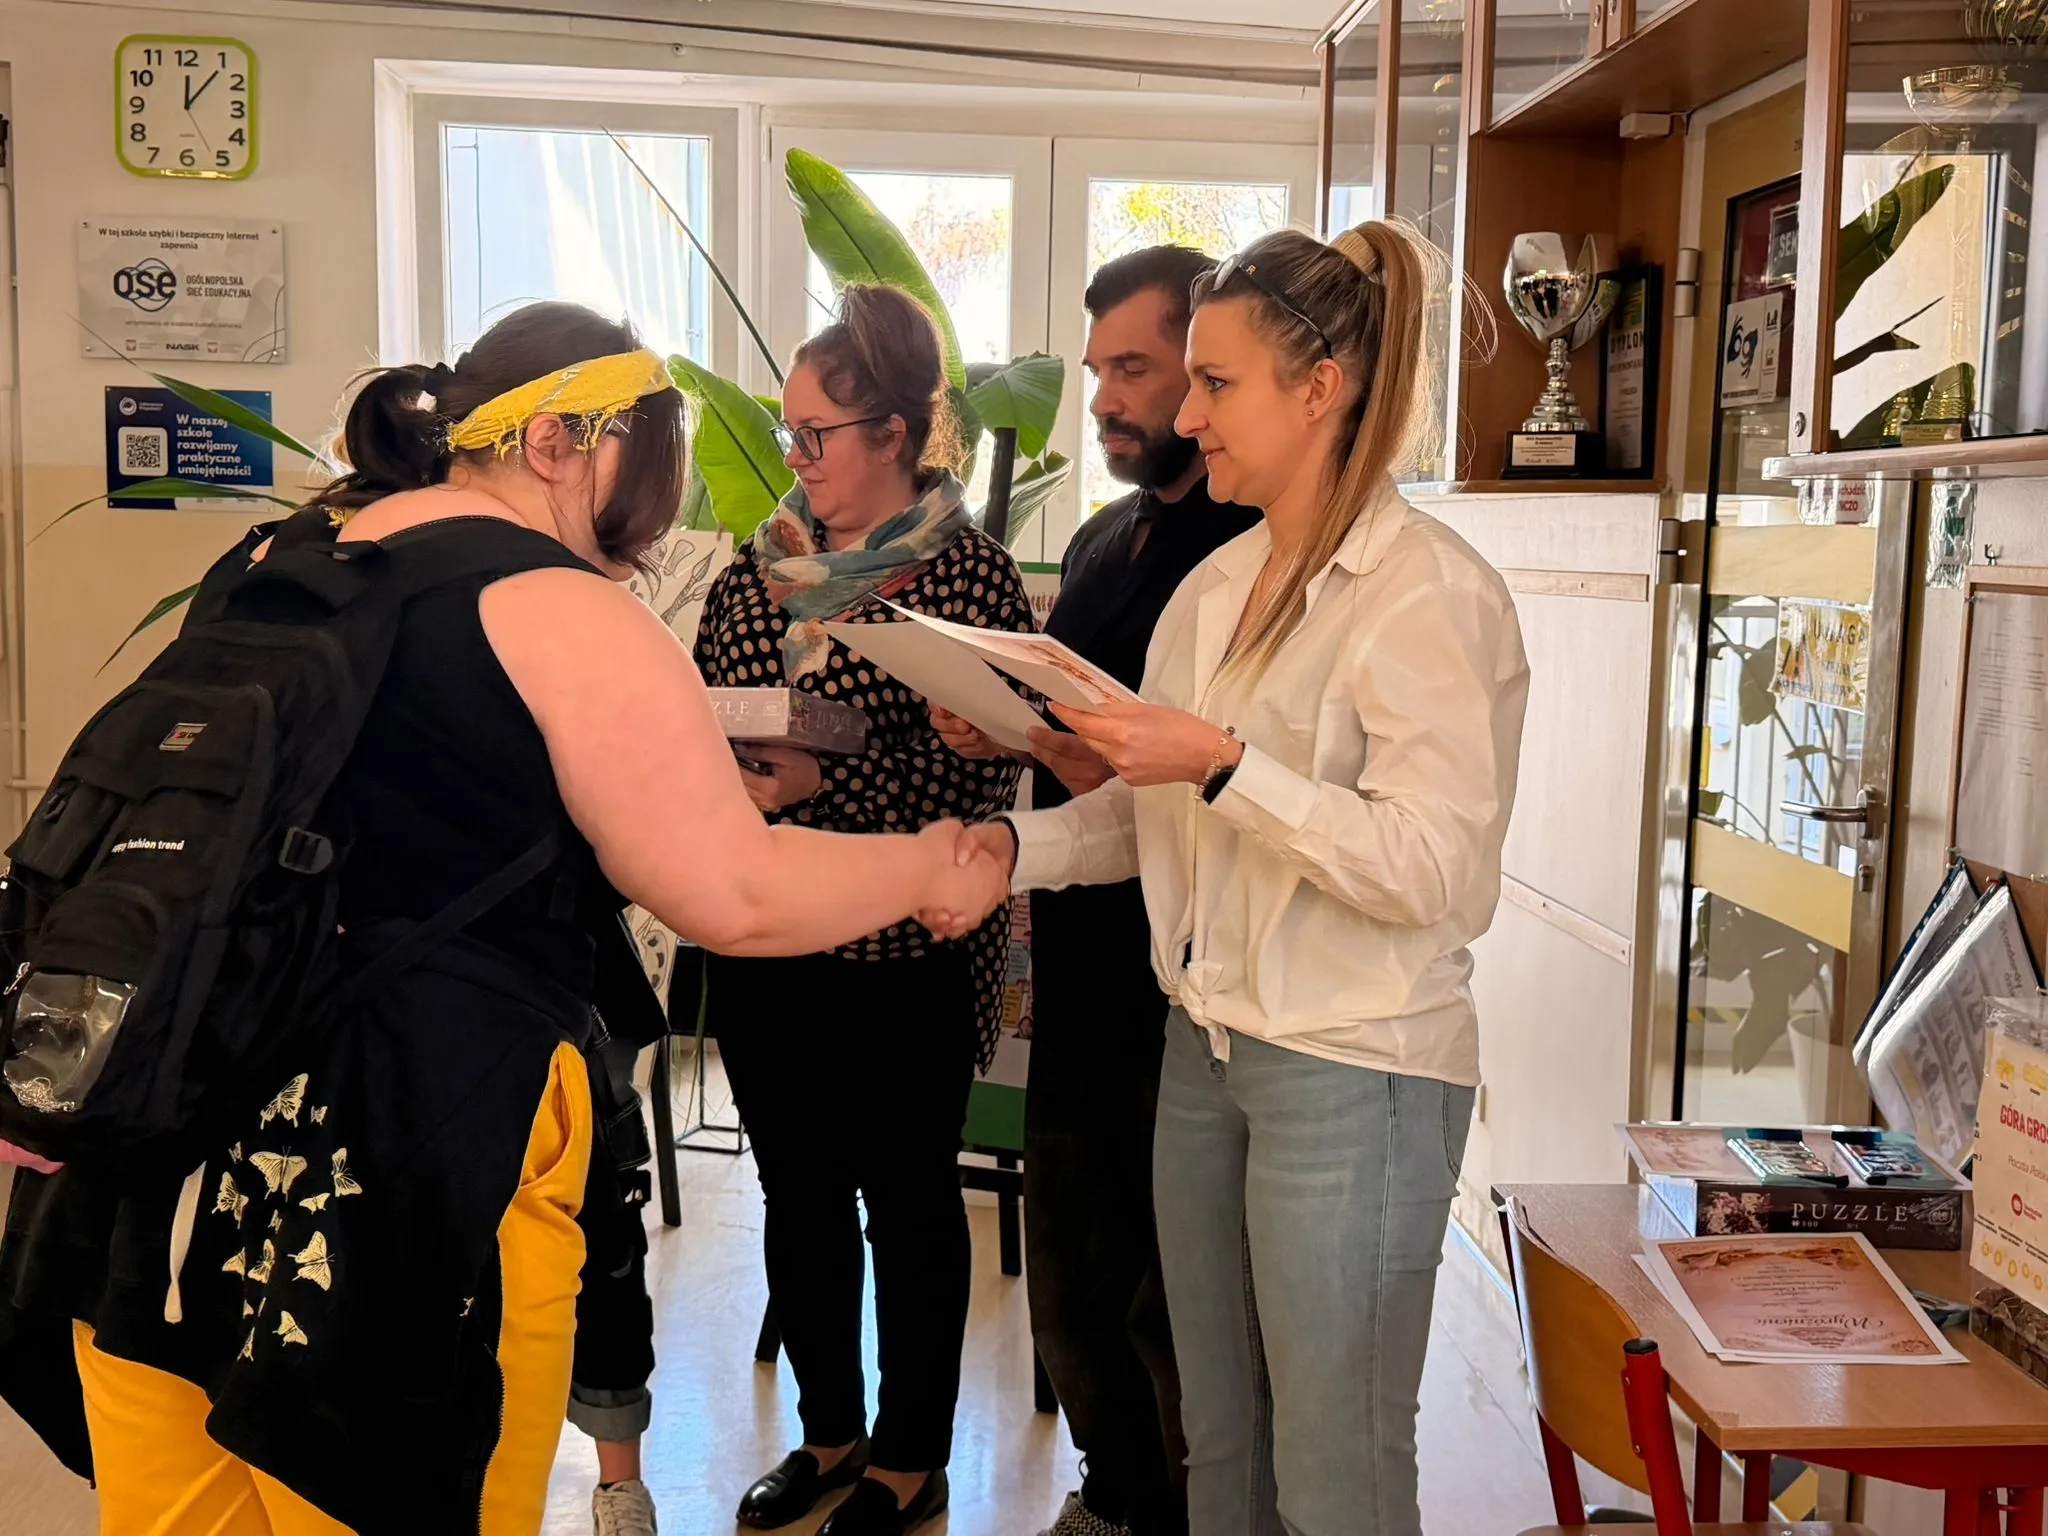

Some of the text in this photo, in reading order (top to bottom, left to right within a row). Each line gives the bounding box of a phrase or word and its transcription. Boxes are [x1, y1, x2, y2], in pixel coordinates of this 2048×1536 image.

[144, 49, 162, 66] 11
[174, 50, 199, 67] 12
[218, 52, 226, 68] 1
[130, 69, 154, 87] 10
[229, 73, 245, 91] 2
[129, 96, 145, 114] 9
[230, 100, 245, 119] 3
[130, 123, 146, 142] 8
[228, 128, 245, 146] 4
[147, 147, 160, 164] 7
[179, 149, 195, 167] 6
[215, 150, 230, 167] 5
[99, 228, 107, 236] W
[148, 228, 174, 239] szybki
[180, 230, 225, 241] bezpieczny
[160, 240, 198, 250] zapewnia
[1778, 230, 1798, 258] SEK
[186, 274, 244, 286] OGÓLNOPOLSKA
[205, 287, 252, 298] EDUKACYJNA
[165, 343, 200, 351] NASK
[176, 413, 228, 428] W naszej
[177, 426, 213, 438] szkole
[177, 439, 239, 454] rozwijamy
[177, 451, 242, 465] praktyczne
[177, 464, 252, 478] umiejętności!
[157, 840, 185, 851] trend
[2000, 1104, 2026, 1134] GÓRA
[1791, 1202, 1908, 1222] PUZZLE
